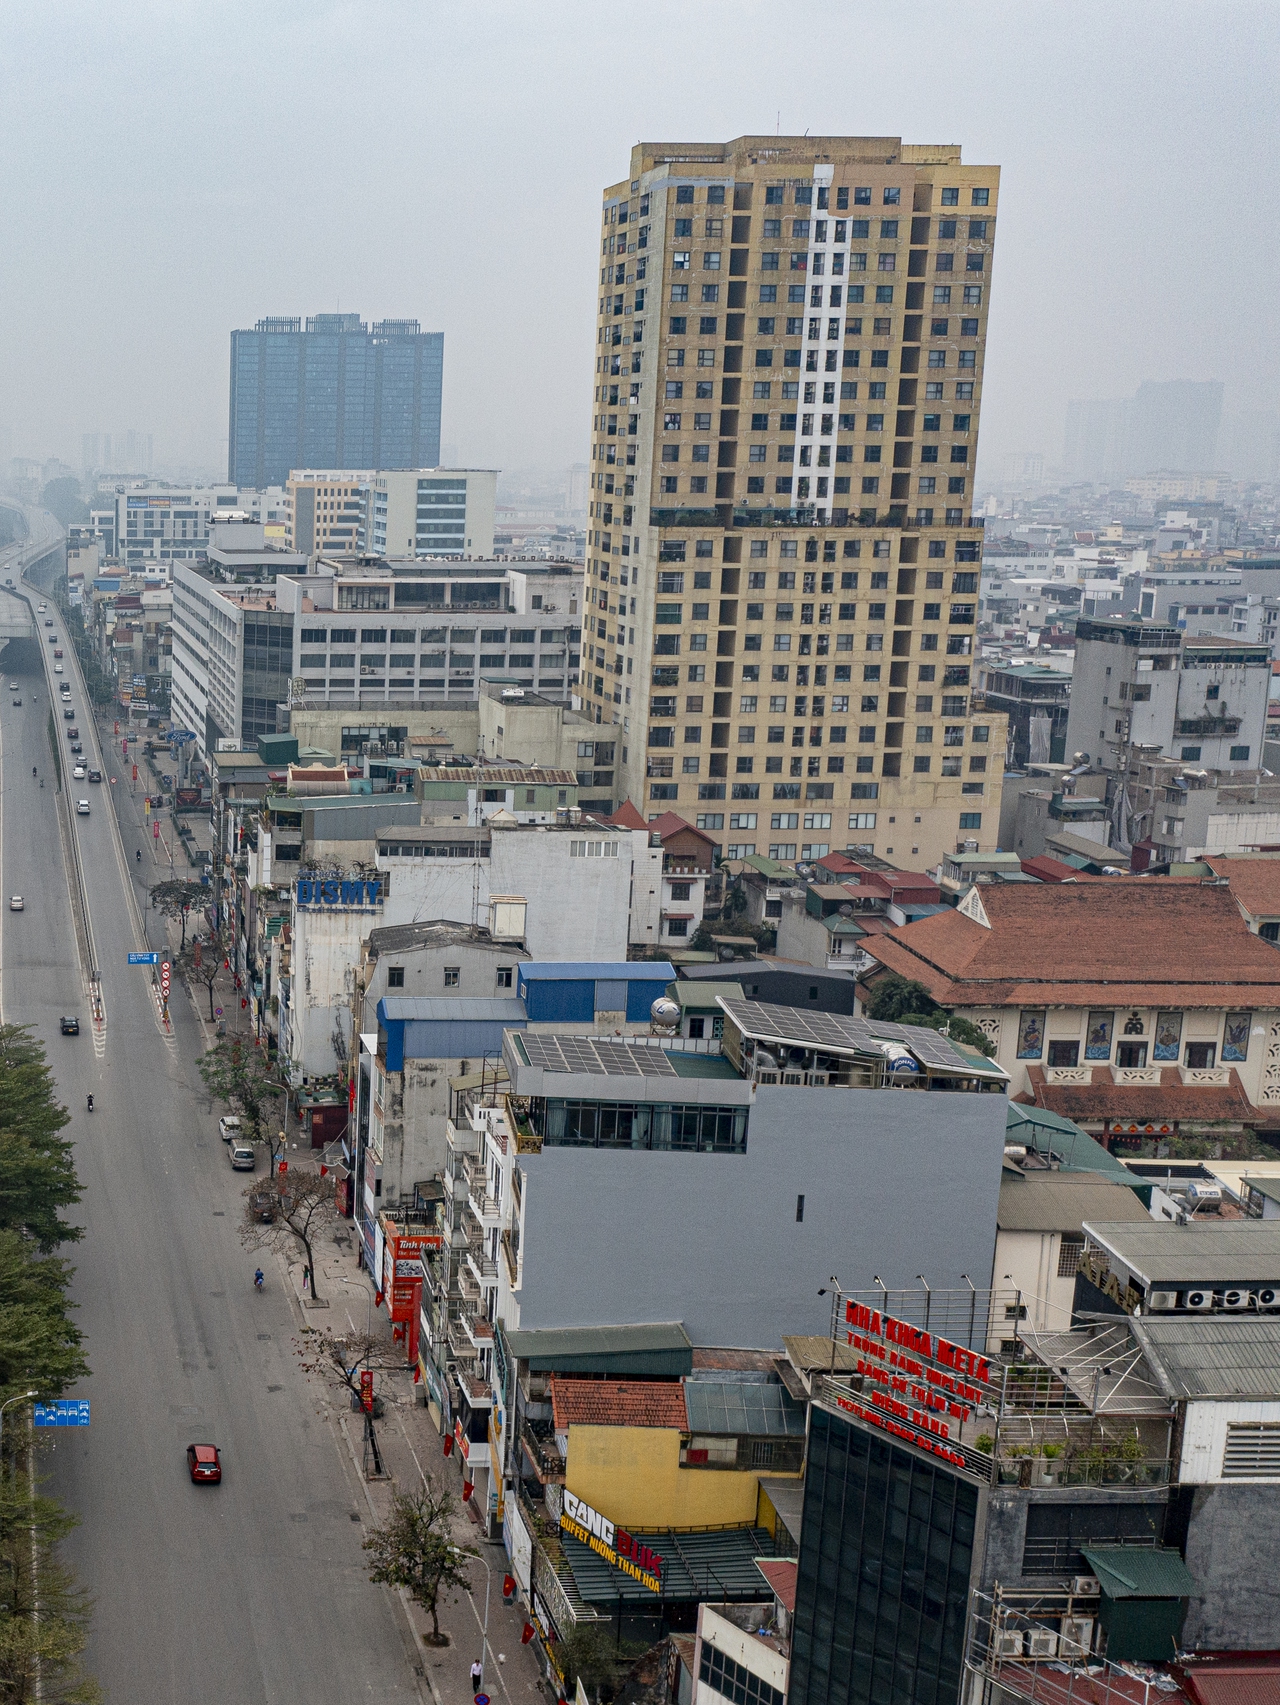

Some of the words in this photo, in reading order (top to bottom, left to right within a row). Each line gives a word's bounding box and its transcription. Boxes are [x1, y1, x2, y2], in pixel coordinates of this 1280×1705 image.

[846, 1299, 881, 1336] NHA
[885, 1317, 933, 1358] KHOA
[937, 1338, 990, 1383] META
[926, 1367, 983, 1404] IMPLANT
[563, 1488, 615, 1546] GANG
[560, 1514, 589, 1544] BUFFET
[589, 1535, 617, 1565] NƯỚNG
[618, 1556, 643, 1582] THAN
[642, 1572, 661, 1593] HOA
